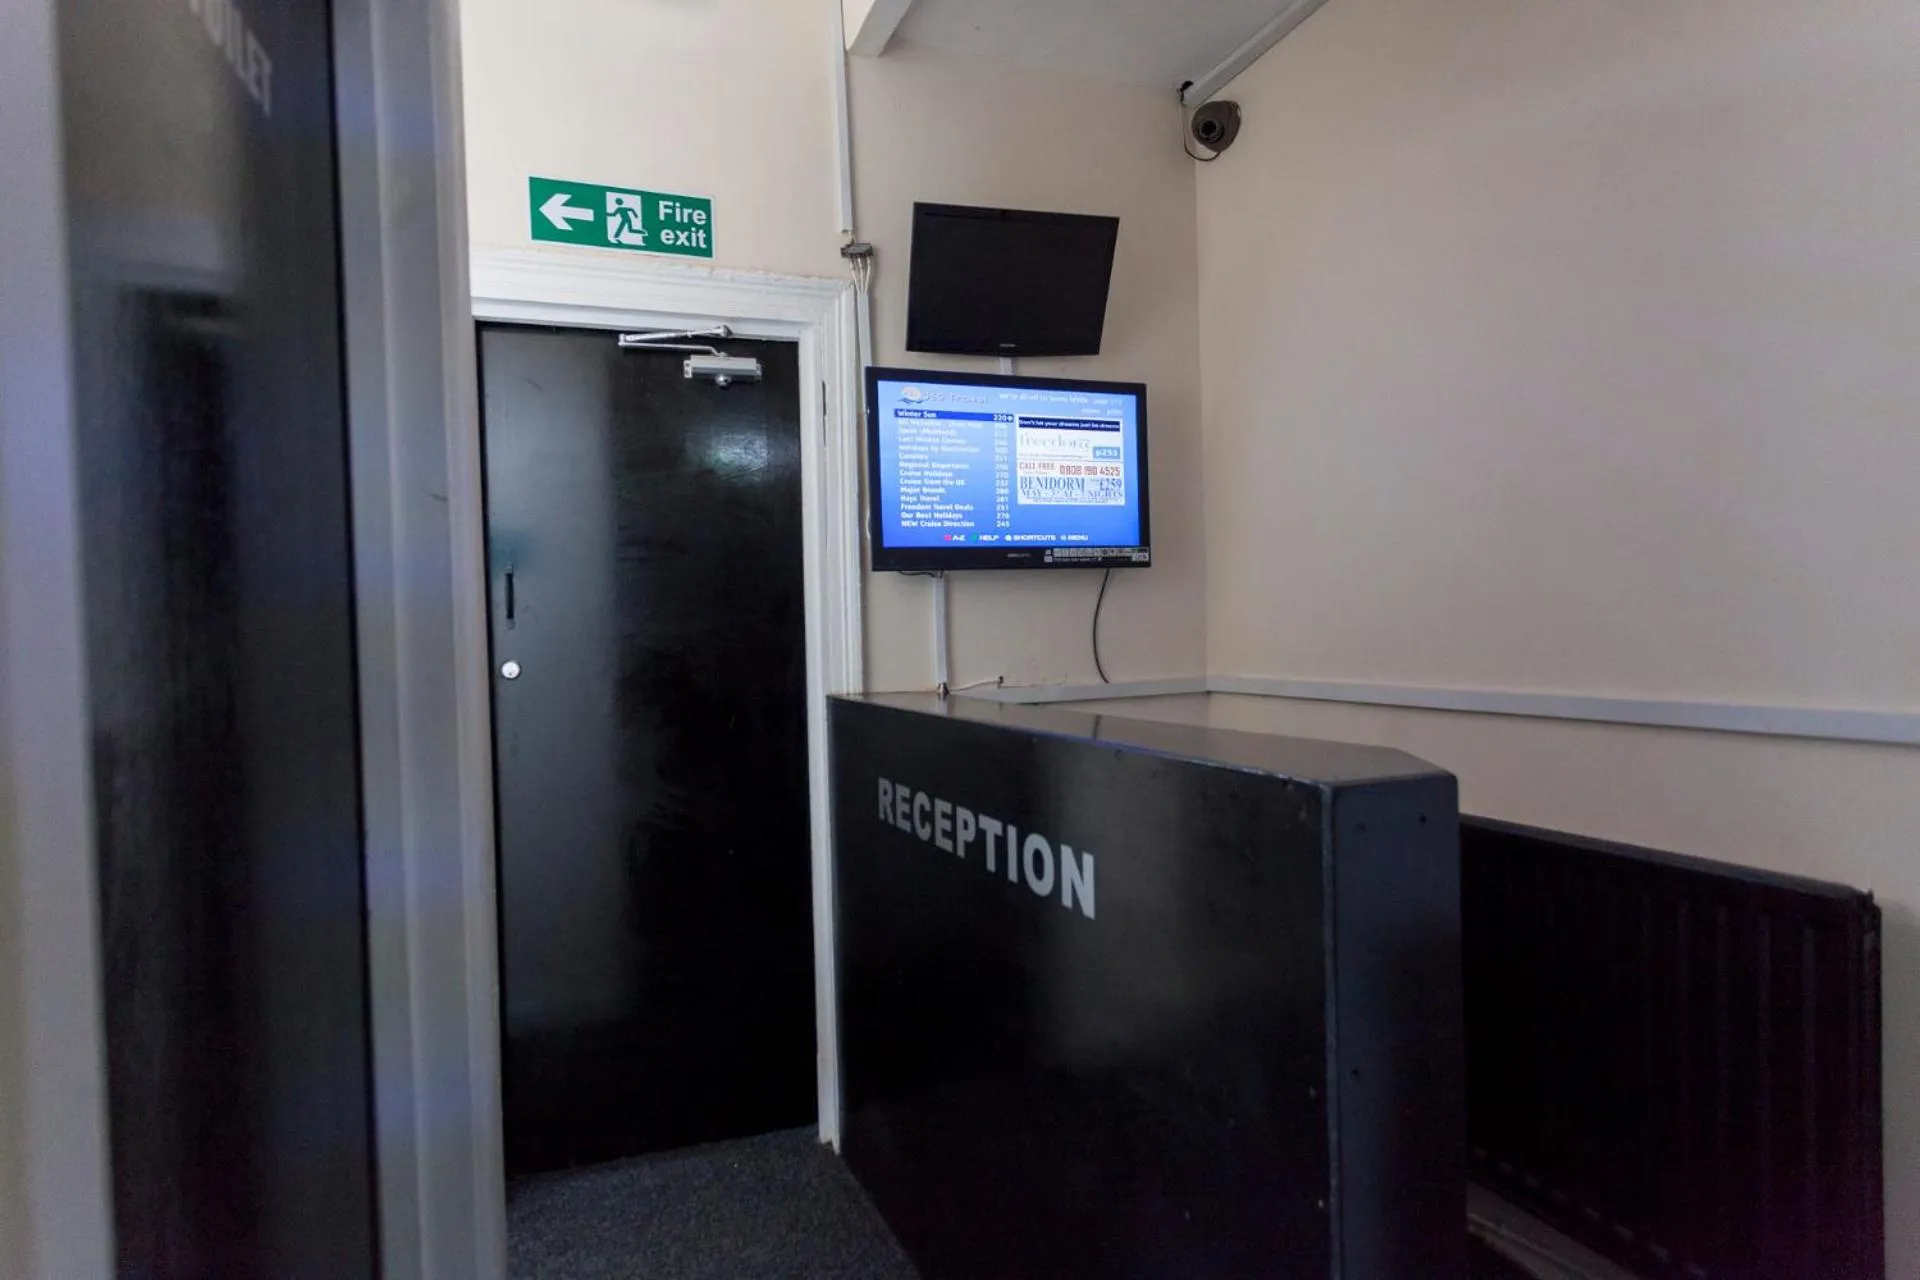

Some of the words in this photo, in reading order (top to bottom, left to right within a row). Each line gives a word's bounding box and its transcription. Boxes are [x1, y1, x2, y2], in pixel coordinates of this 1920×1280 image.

[189, 0, 272, 119] OILET
[659, 200, 707, 225] Fire
[660, 227, 708, 249] exit
[1020, 462, 1036, 470] CALL
[1038, 462, 1054, 470] FREE
[1020, 476, 1085, 491] BENIDORM
[1100, 478, 1122, 491] £259
[933, 512, 963, 520] Holidays
[877, 776, 1096, 920] RECEPTION
